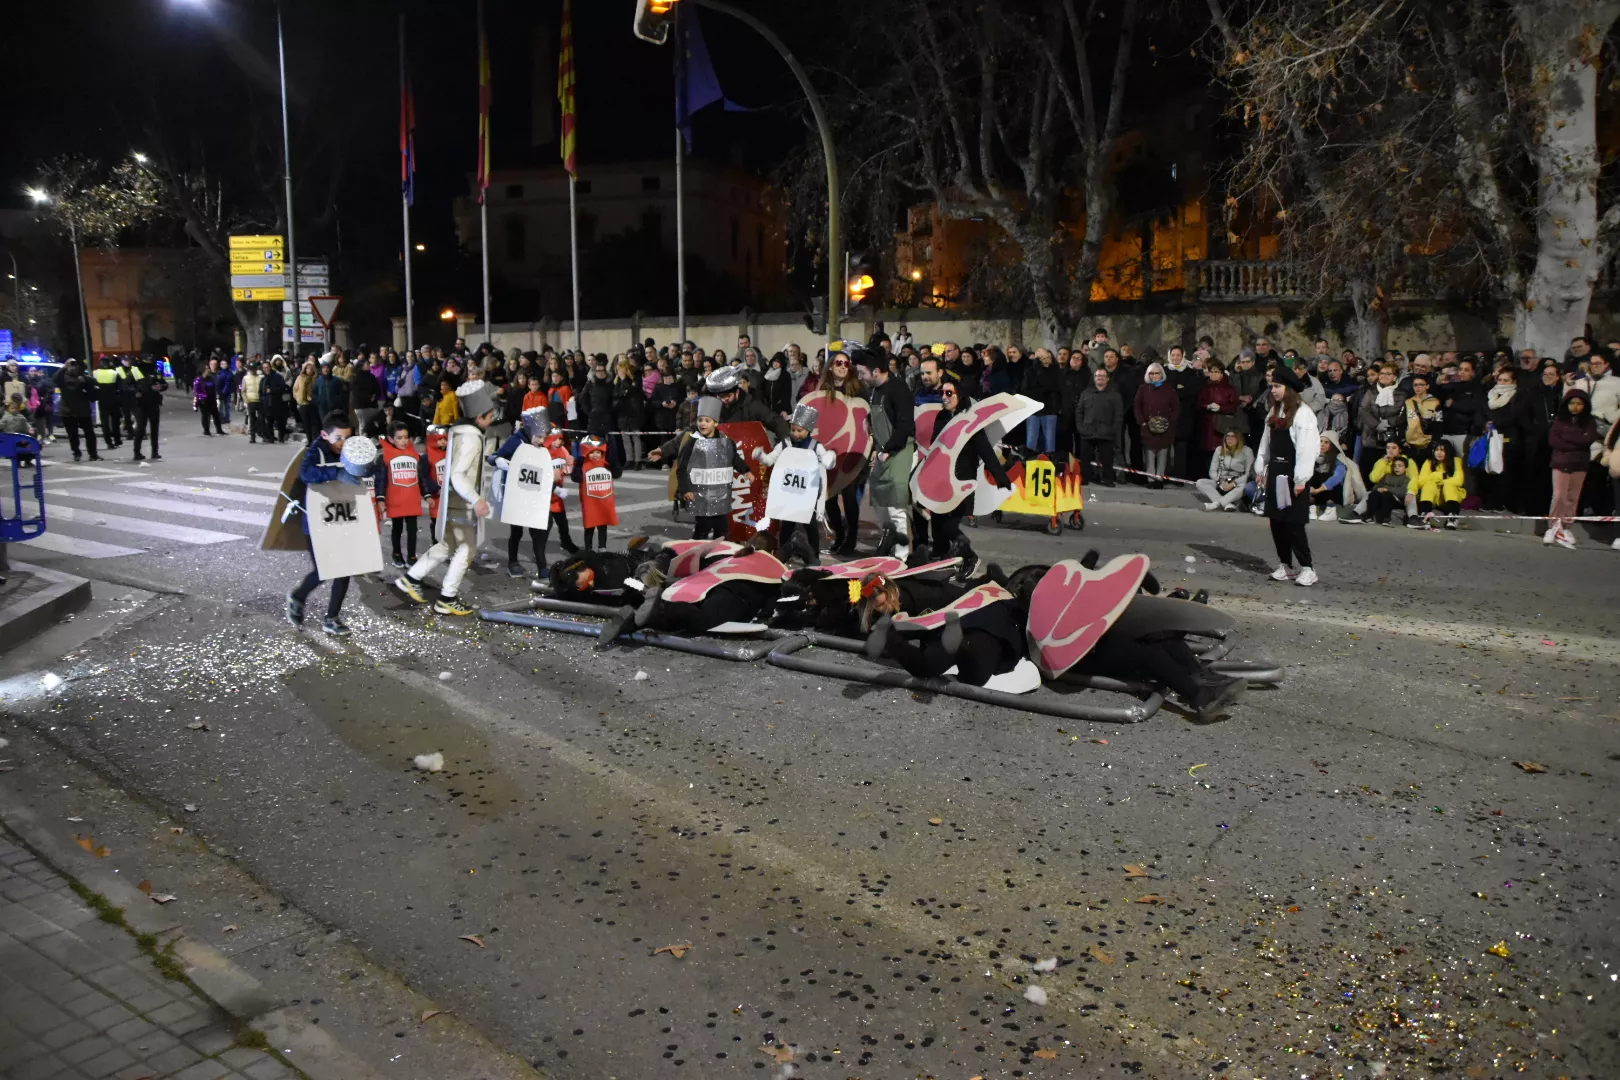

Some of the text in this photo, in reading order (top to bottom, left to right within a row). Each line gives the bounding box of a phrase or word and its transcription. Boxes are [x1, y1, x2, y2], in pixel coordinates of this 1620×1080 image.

[392, 461, 416, 470] TOMATO
[518, 468, 540, 486] SAL
[588, 473, 610, 482] TOMATO
[784, 473, 806, 489] SAL
[1032, 468, 1052, 498] 15
[324, 502, 357, 522] SAL
